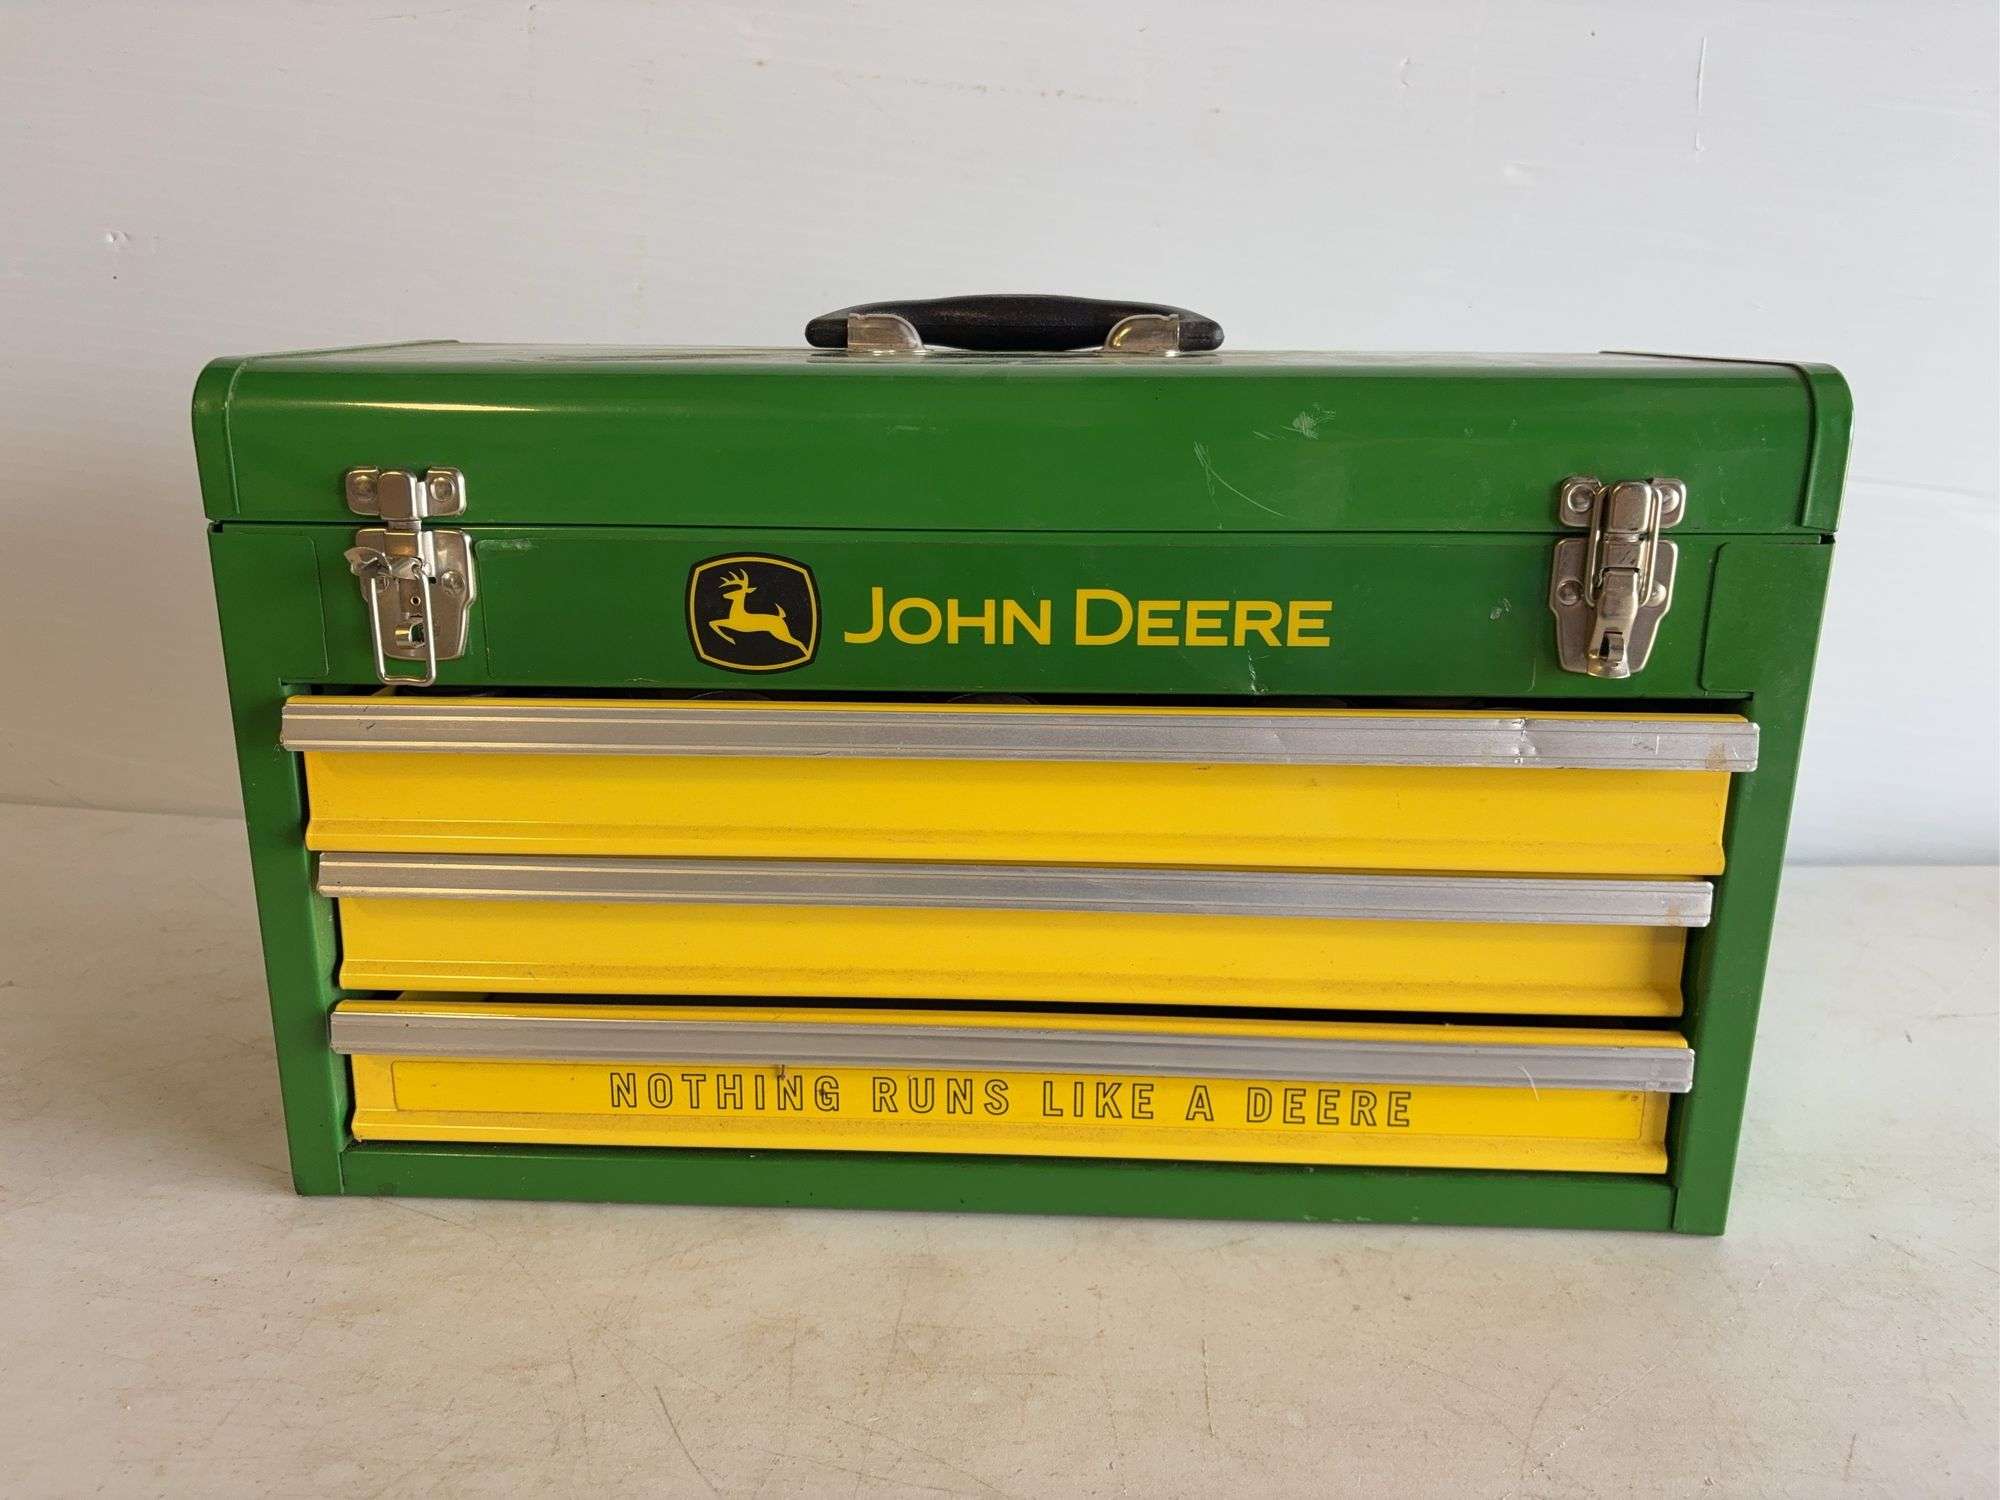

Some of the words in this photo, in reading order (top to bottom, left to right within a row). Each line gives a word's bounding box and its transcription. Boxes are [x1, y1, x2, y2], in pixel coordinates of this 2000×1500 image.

[844, 586, 1052, 646] JOHN
[1076, 588, 1333, 648] DEERE
[610, 1072, 842, 1113] NOTHING
[873, 1077, 1010, 1115] RUNS
[1043, 1081, 1155, 1121] LIKE
[1186, 1083, 1216, 1122] A
[1246, 1086, 1414, 1128] DEERE
